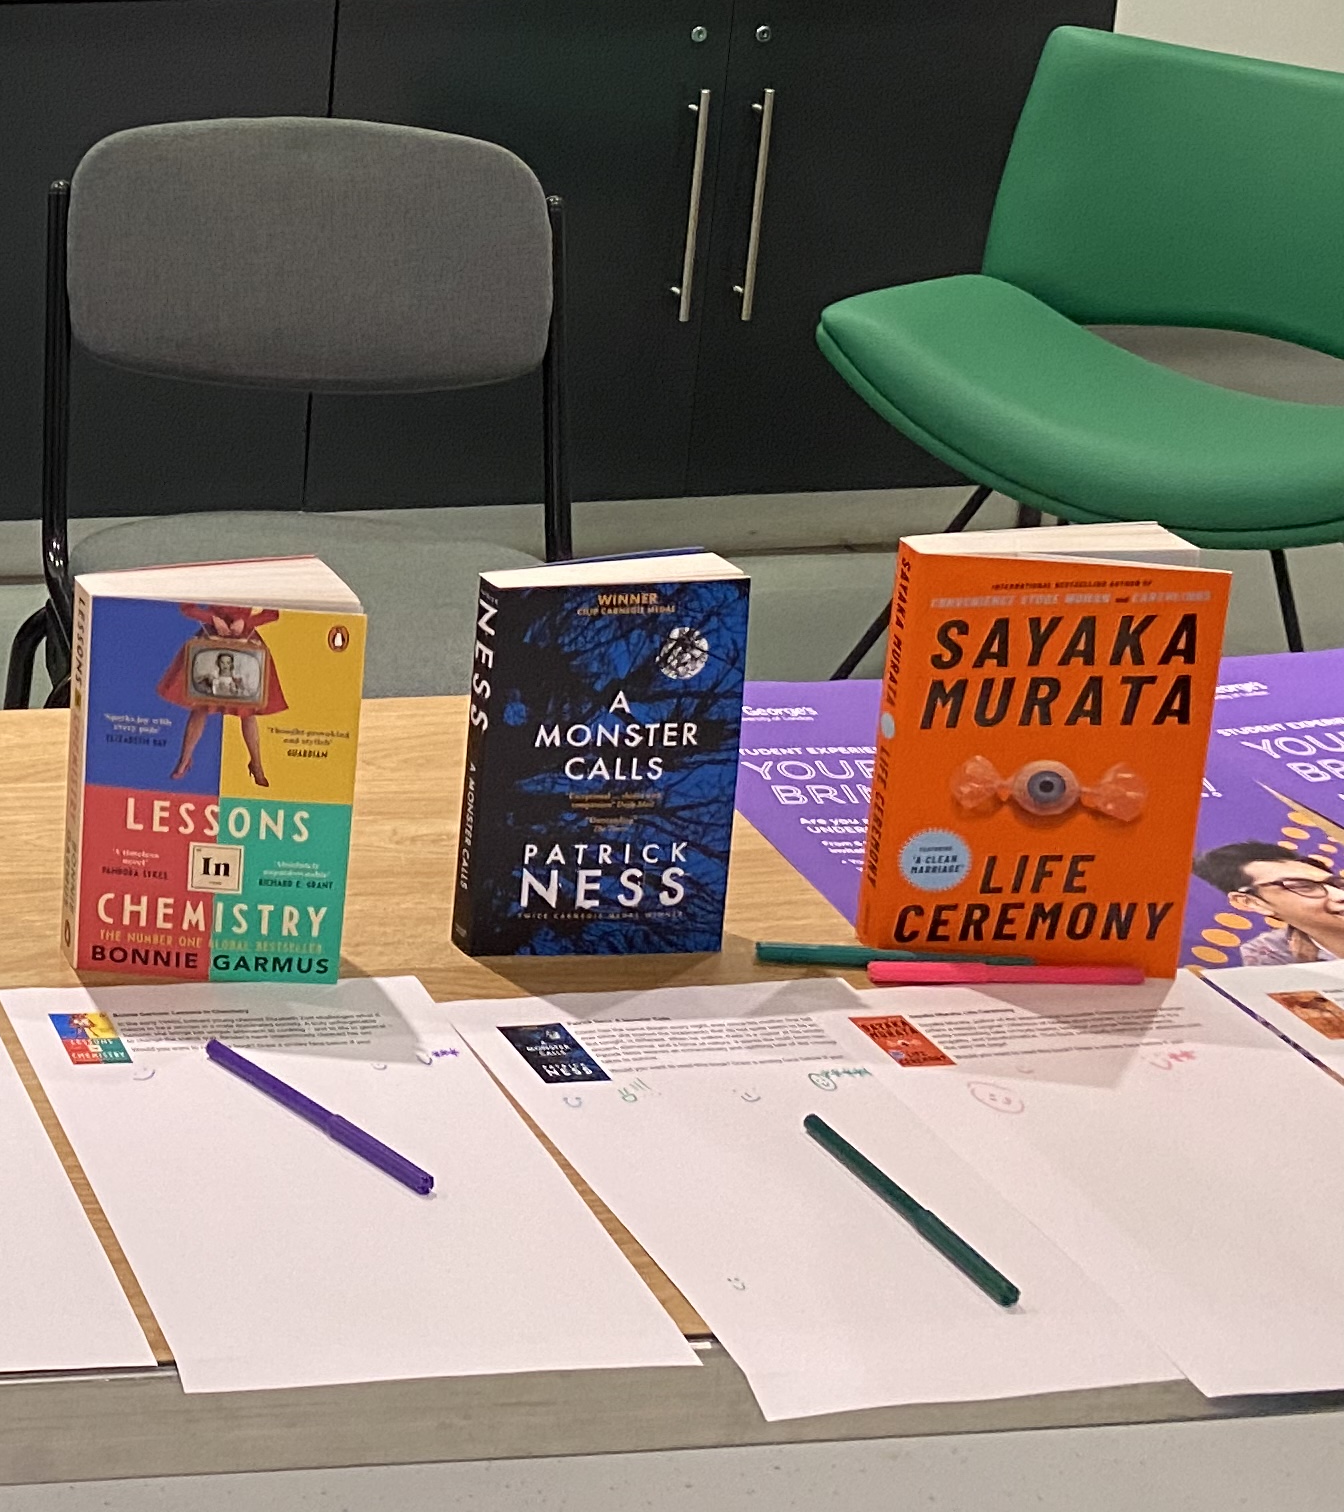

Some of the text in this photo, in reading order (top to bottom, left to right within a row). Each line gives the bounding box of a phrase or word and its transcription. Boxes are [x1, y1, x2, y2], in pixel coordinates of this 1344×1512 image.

[598, 592, 658, 606] WINNER
[74, 596, 86, 687] LESSONS
[886, 557, 911, 707] SAYAKA MURATA
[930, 613, 1198, 670] SAYAKA
[470, 598, 499, 731] NESS
[608, 690, 631, 714] A
[919, 674, 1192, 730] MURATA
[534, 722, 698, 748] MONSTER
[564, 757, 663, 781] CALLS
[126, 797, 310, 843] LESSONS
[870, 791, 887, 888] CEREMONY
[202, 856, 231, 878] In
[523, 841, 688, 866] PATRICK
[925, 854, 958, 864] CLEAN
[979, 854, 1096, 895] LIFE
[520, 866, 686, 910] NESS
[97, 892, 328, 938] CHEMISTRY
[893, 901, 1174, 944] CEREMONY
[91, 945, 330, 975] BONNIE GARMUS
[99, 929, 203, 949] THE NUMBER ONE
